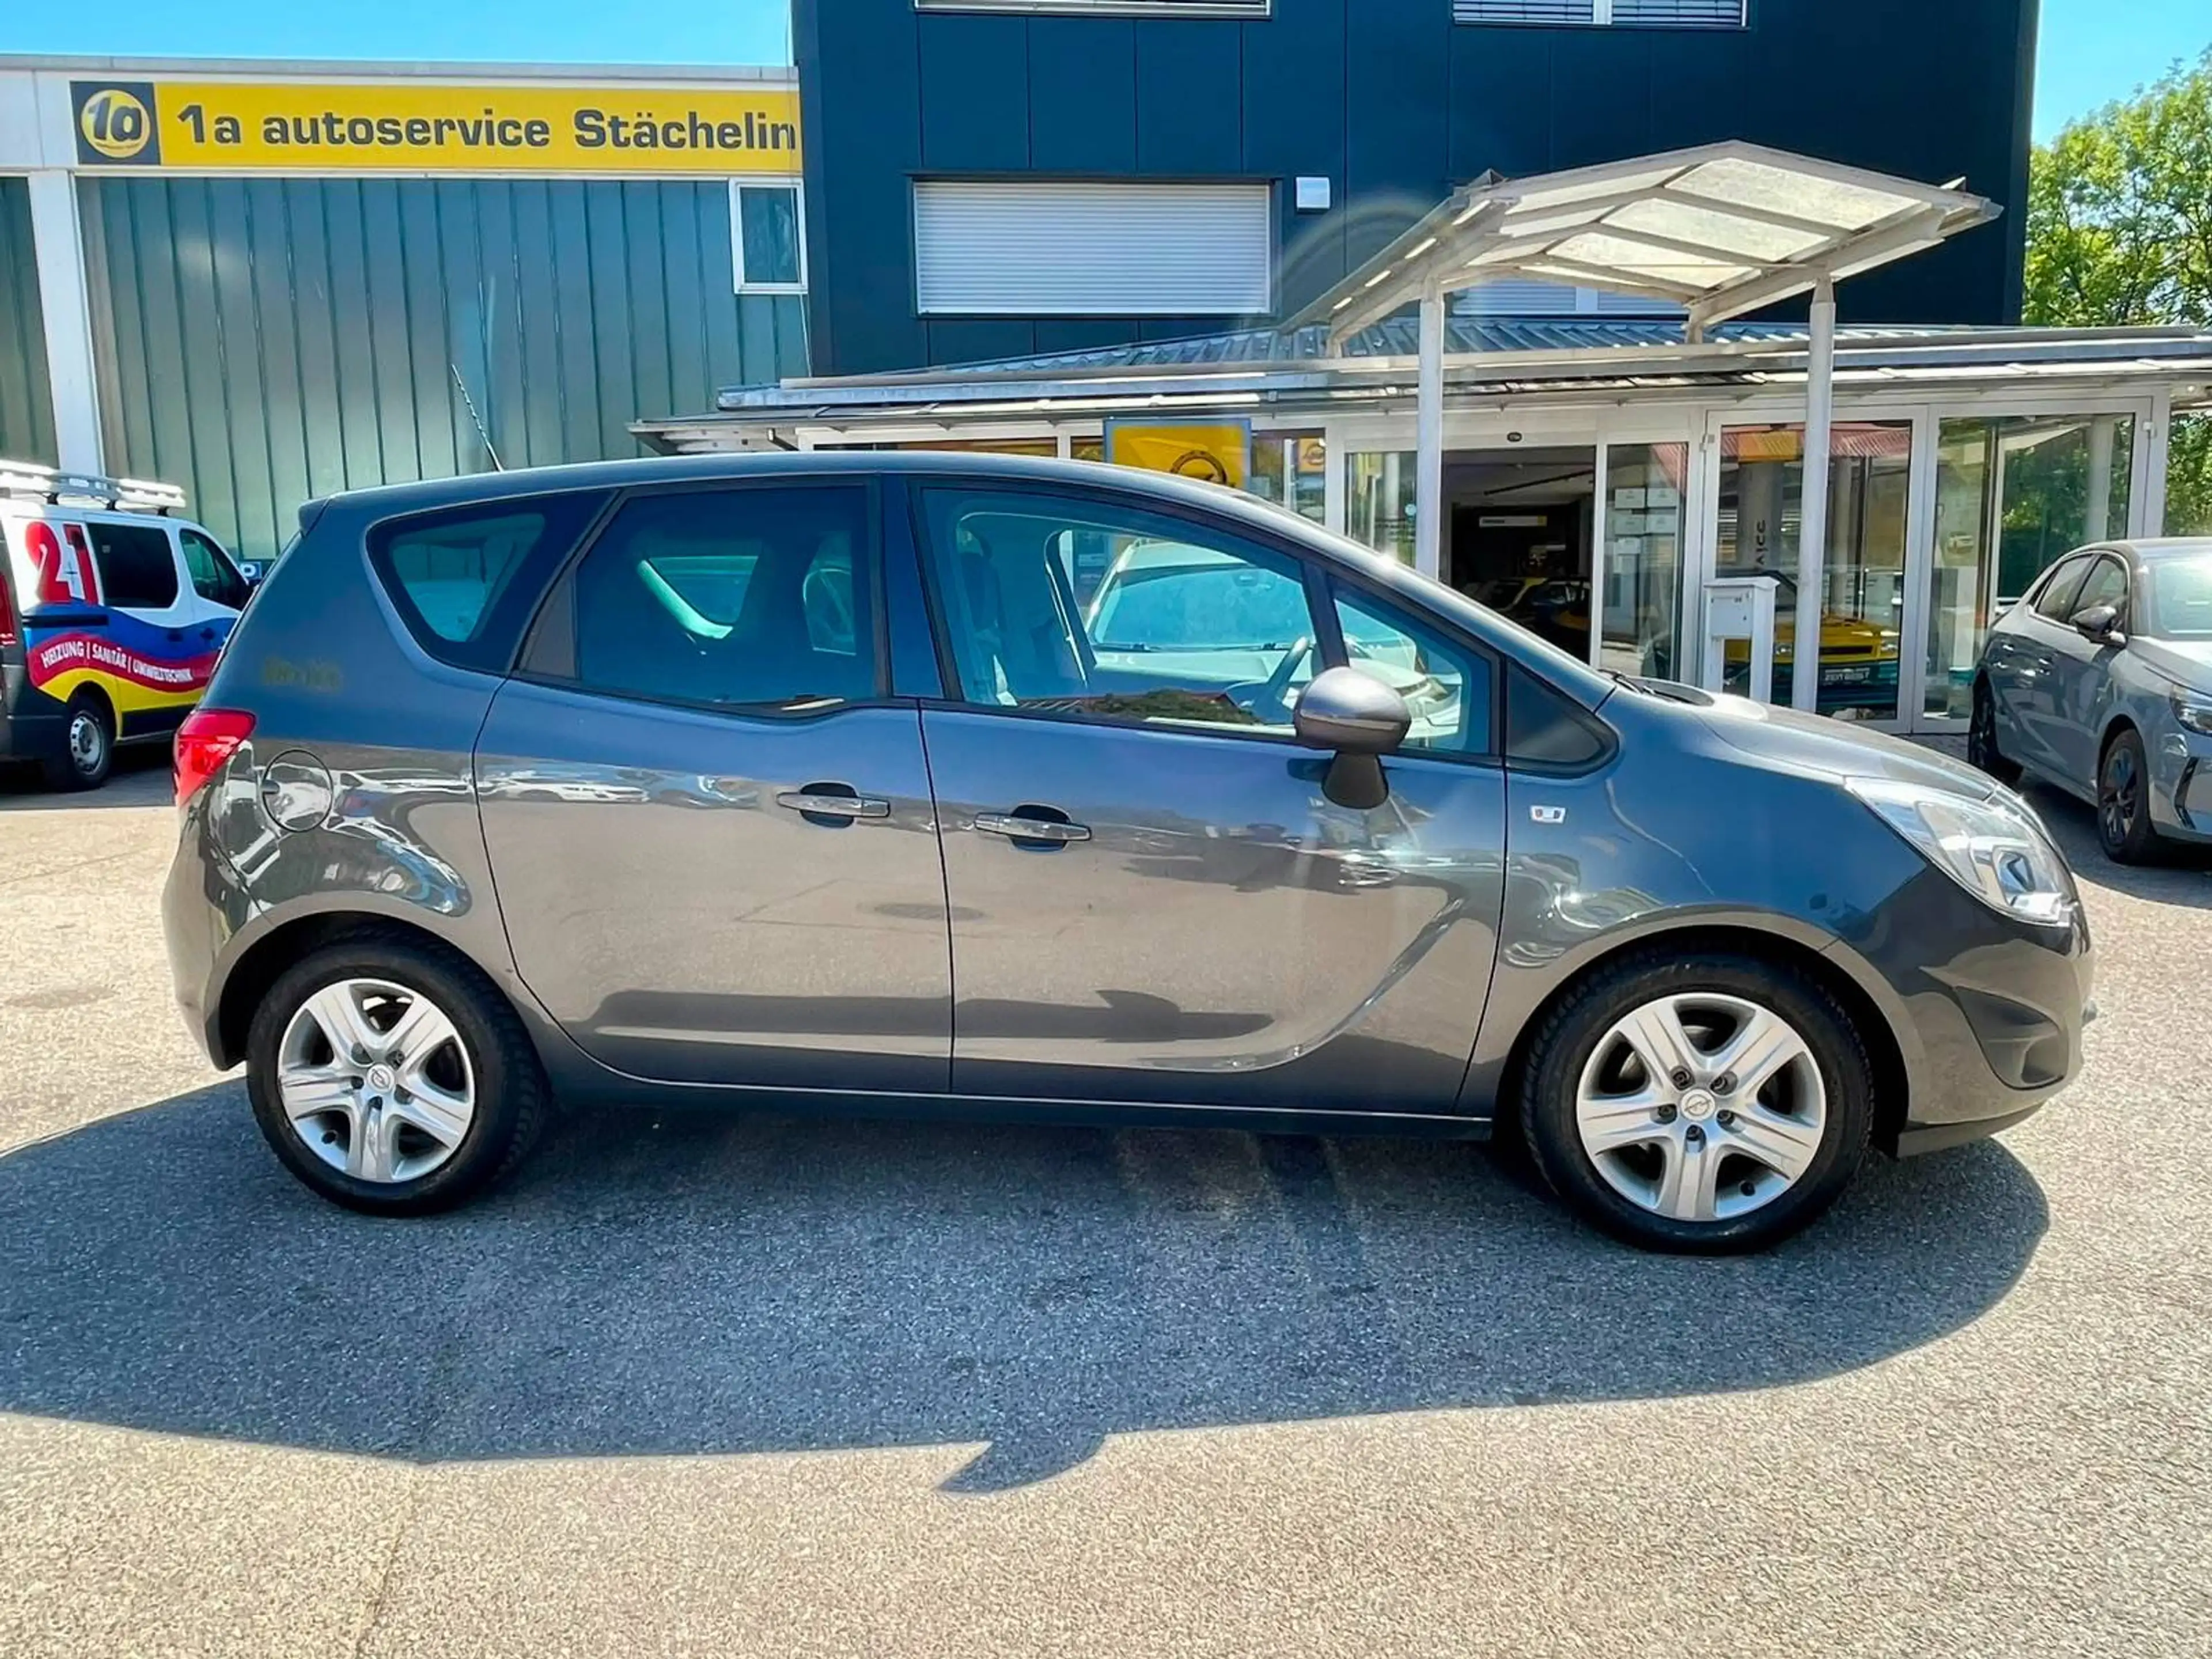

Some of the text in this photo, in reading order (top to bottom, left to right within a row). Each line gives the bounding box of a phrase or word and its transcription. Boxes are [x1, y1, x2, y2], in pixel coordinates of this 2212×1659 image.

[88, 96, 143, 142] 1a
[177, 105, 796, 150] 1a autoservice Stächelin
[40, 641, 85, 669] HEIZUNG
